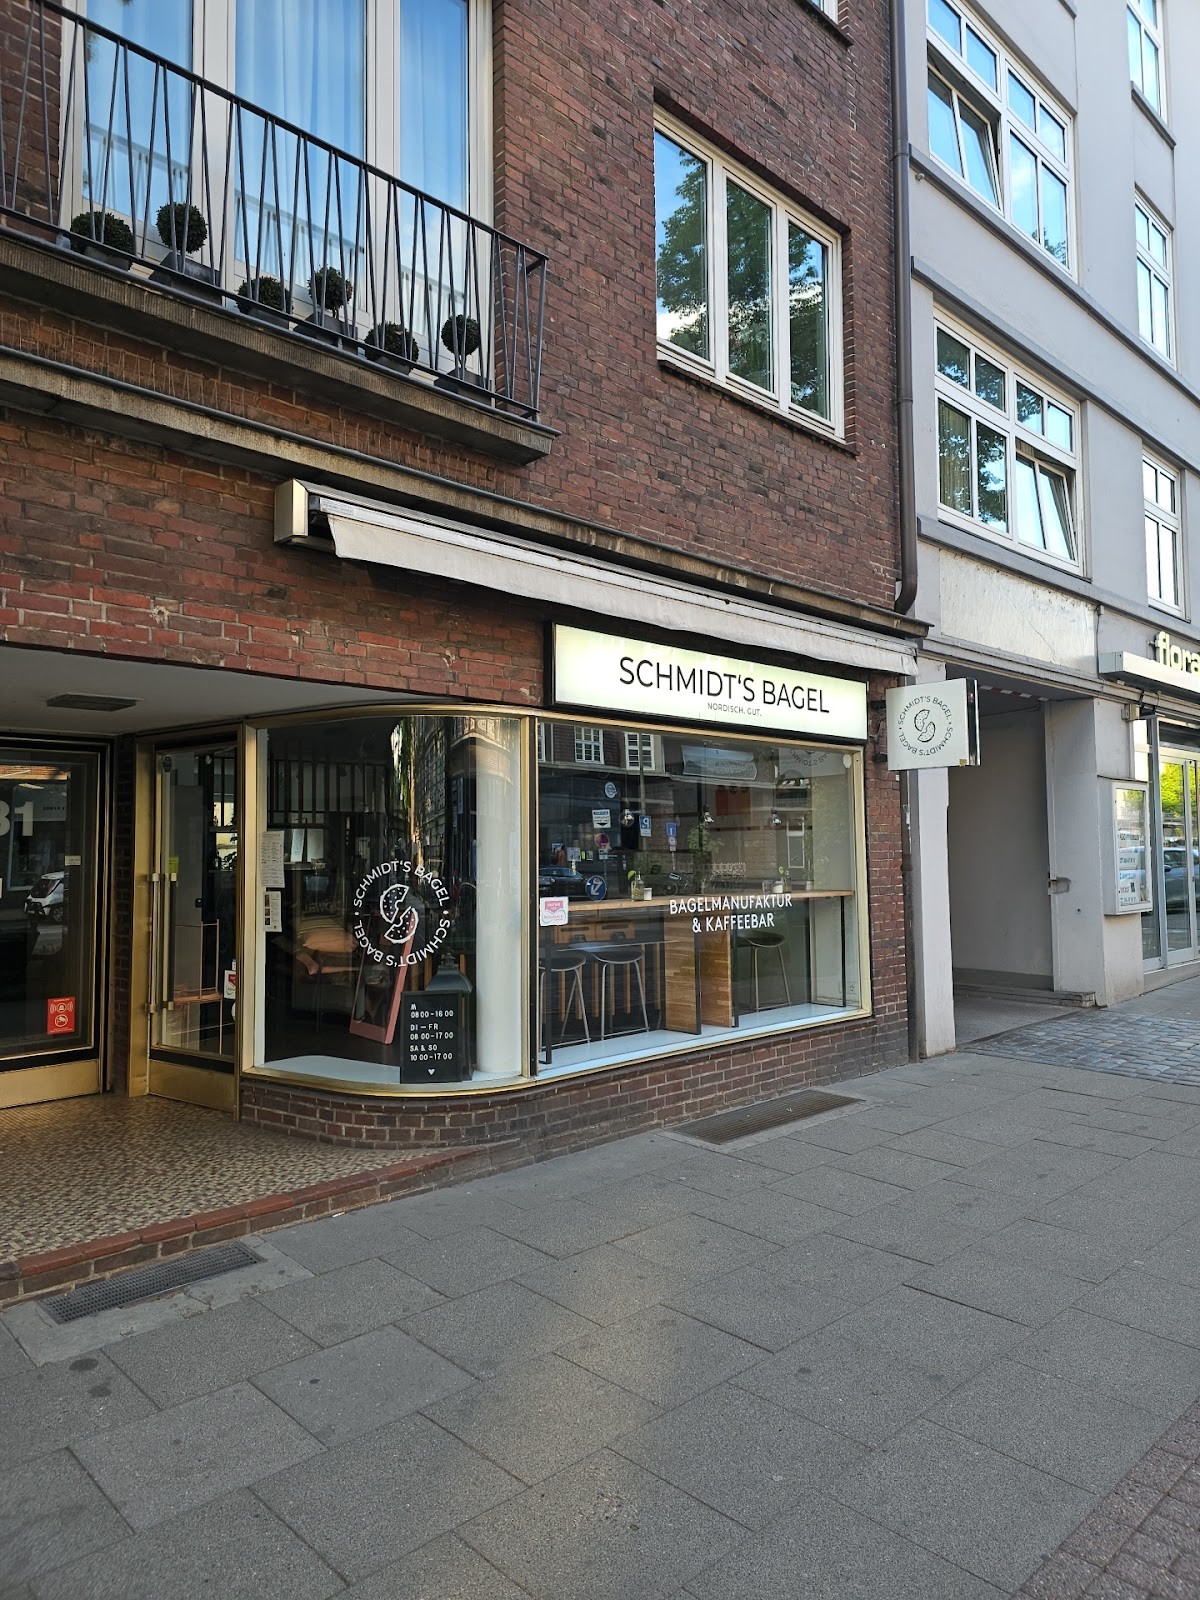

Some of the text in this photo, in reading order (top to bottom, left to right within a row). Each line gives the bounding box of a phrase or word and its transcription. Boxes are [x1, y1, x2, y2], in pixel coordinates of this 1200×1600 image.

[619, 656, 830, 713] SCHMIDT'S BAGEL
[707, 702, 762, 717] NORDISCH. GUT.
[898, 695, 952, 725] SCHMIDT'S BAGEL
[353, 860, 450, 908] SCHMIDT'S BAGEL
[669, 893, 793, 915] BAGELMANUFAKTUR
[692, 913, 775, 933] & KAFFEEBAR
[354, 918, 450, 967] SCHMIDT'S BAGEL
[409, 1044, 419, 1052] SA
